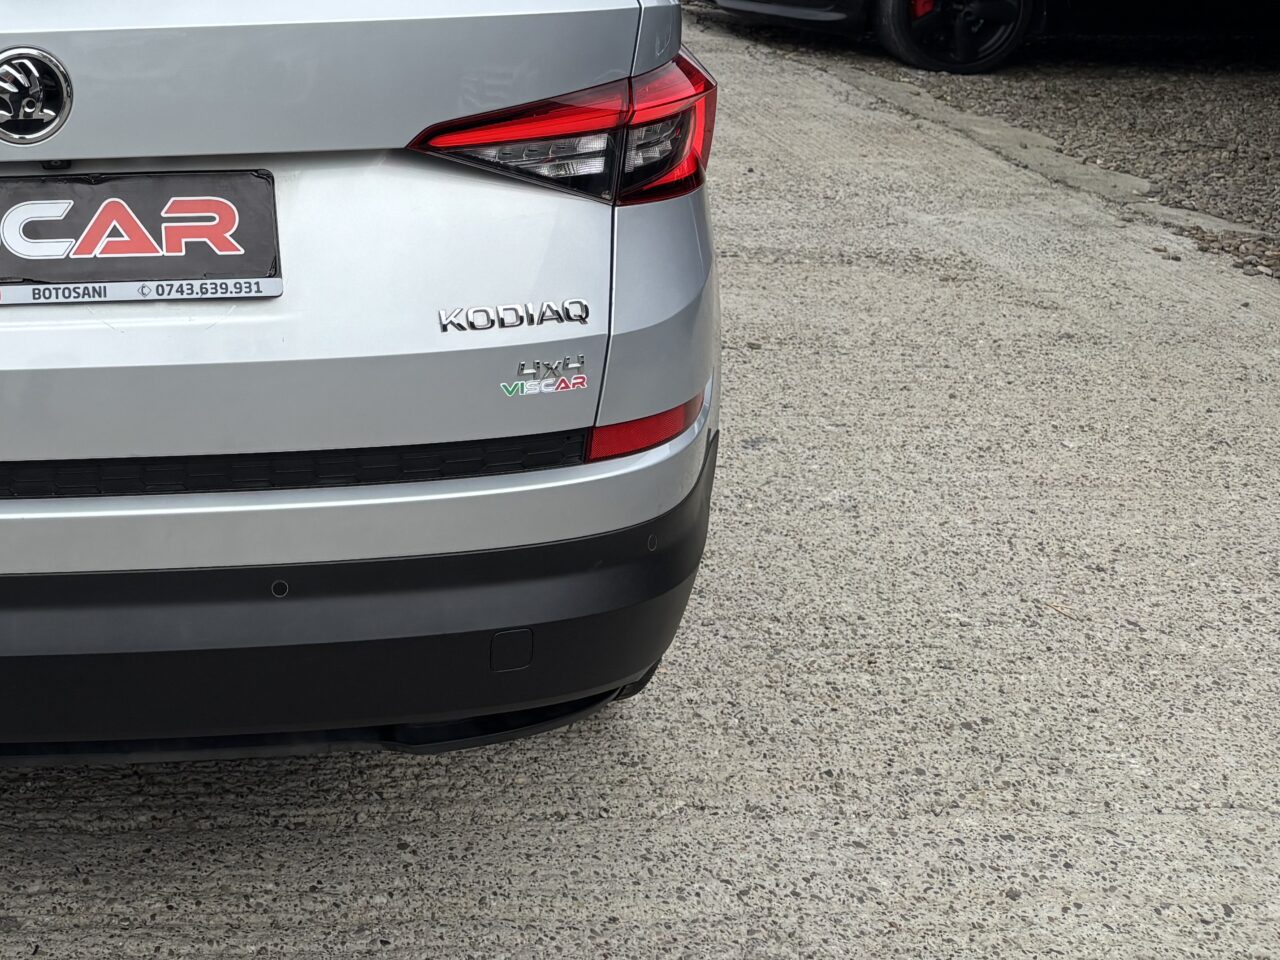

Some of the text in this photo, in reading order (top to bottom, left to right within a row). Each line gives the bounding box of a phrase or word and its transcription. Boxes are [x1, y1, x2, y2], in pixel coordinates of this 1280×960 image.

[32, 285, 107, 300] BOTOSANI
[155, 281, 263, 297] 0743.639.931
[438, 298, 590, 333] KODIAQ
[500, 374, 588, 397] VISCAR
